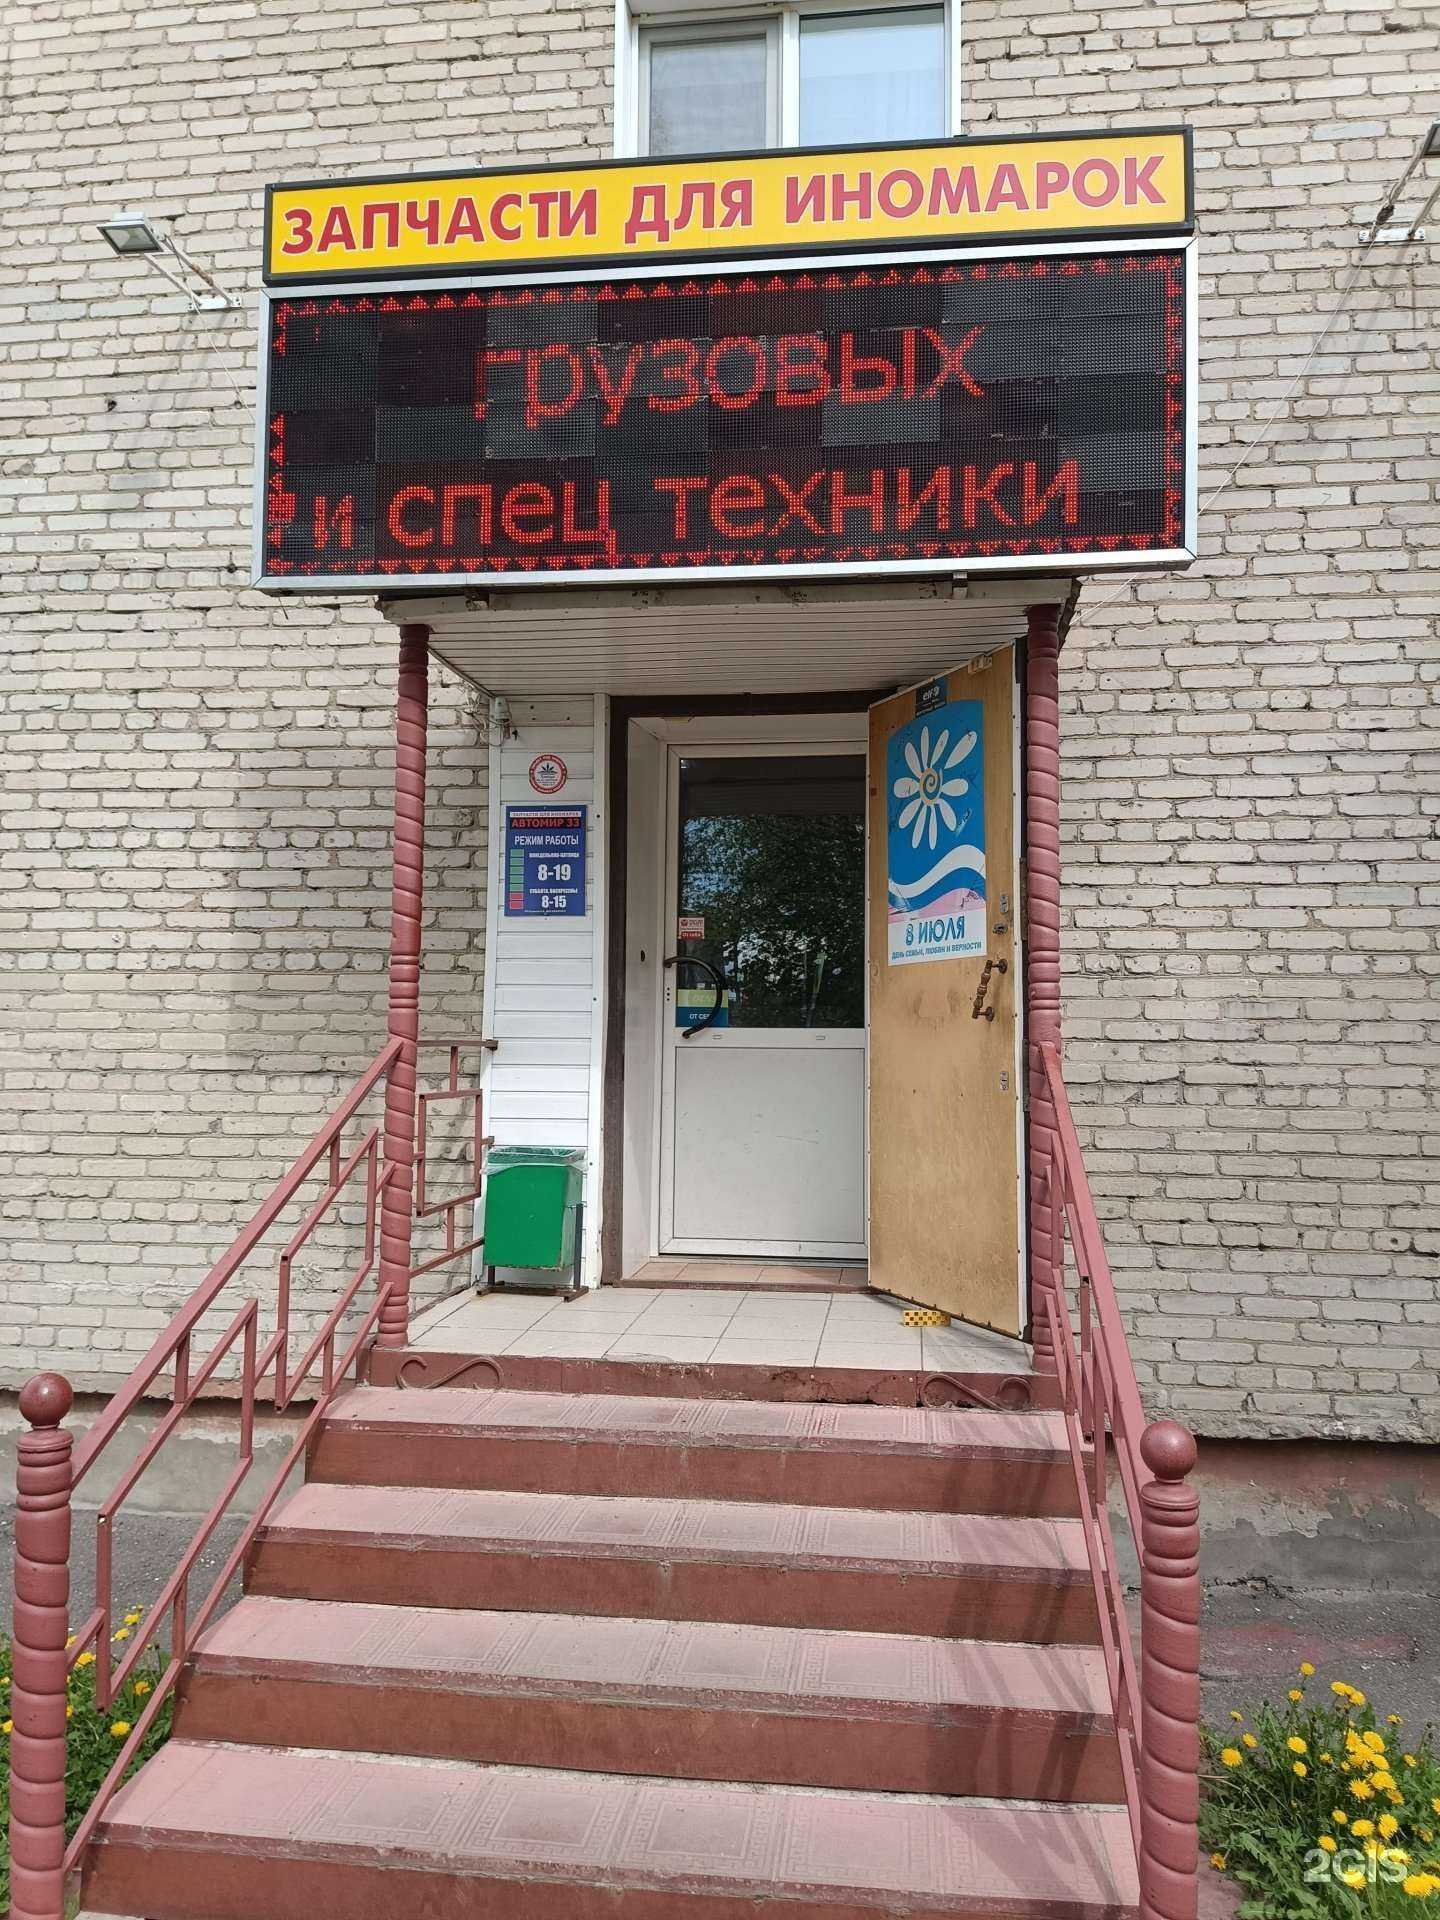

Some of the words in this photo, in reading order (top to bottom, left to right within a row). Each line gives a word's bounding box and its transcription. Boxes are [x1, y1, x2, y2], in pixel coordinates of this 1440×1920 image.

[281, 188, 598, 255] ЗАПЧАСТИ
[623, 178, 753, 245] ДЛЯ
[785, 154, 1167, 225] ИНОМАРОК
[313, 494, 353, 550] и
[387, 478, 618, 563] спец
[653, 457, 1079, 541] техники
[512, 818, 564, 828] АВТОМИР
[566, 818, 580, 827] 33
[514, 835, 544, 845] РЕЖИМ
[545, 834, 579, 845] РАБОТЫ
[538, 863, 571, 881] 8-19
[541, 895, 567, 908] 8-15
[905, 923, 914, 946] 8
[918, 915, 965, 944] ИЮЛЯ
